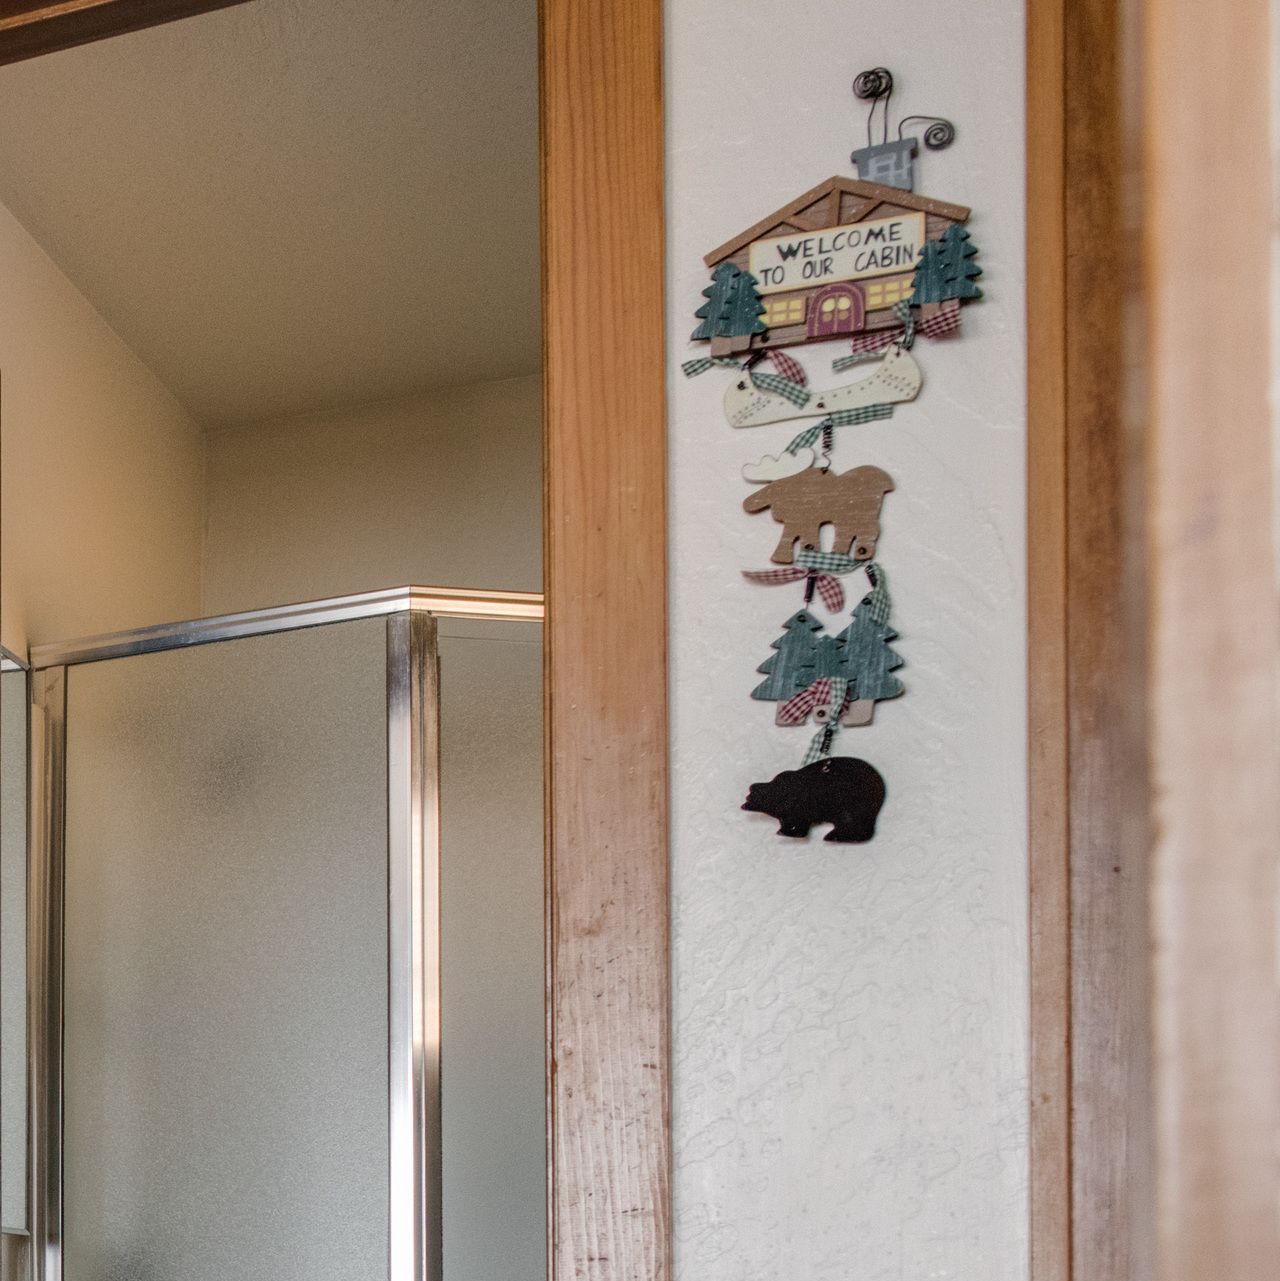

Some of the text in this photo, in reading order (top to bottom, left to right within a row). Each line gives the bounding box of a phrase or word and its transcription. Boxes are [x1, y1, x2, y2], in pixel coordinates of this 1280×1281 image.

[777, 222, 903, 262] WELCOME
[760, 244, 913, 286] TO OUR CABIN
